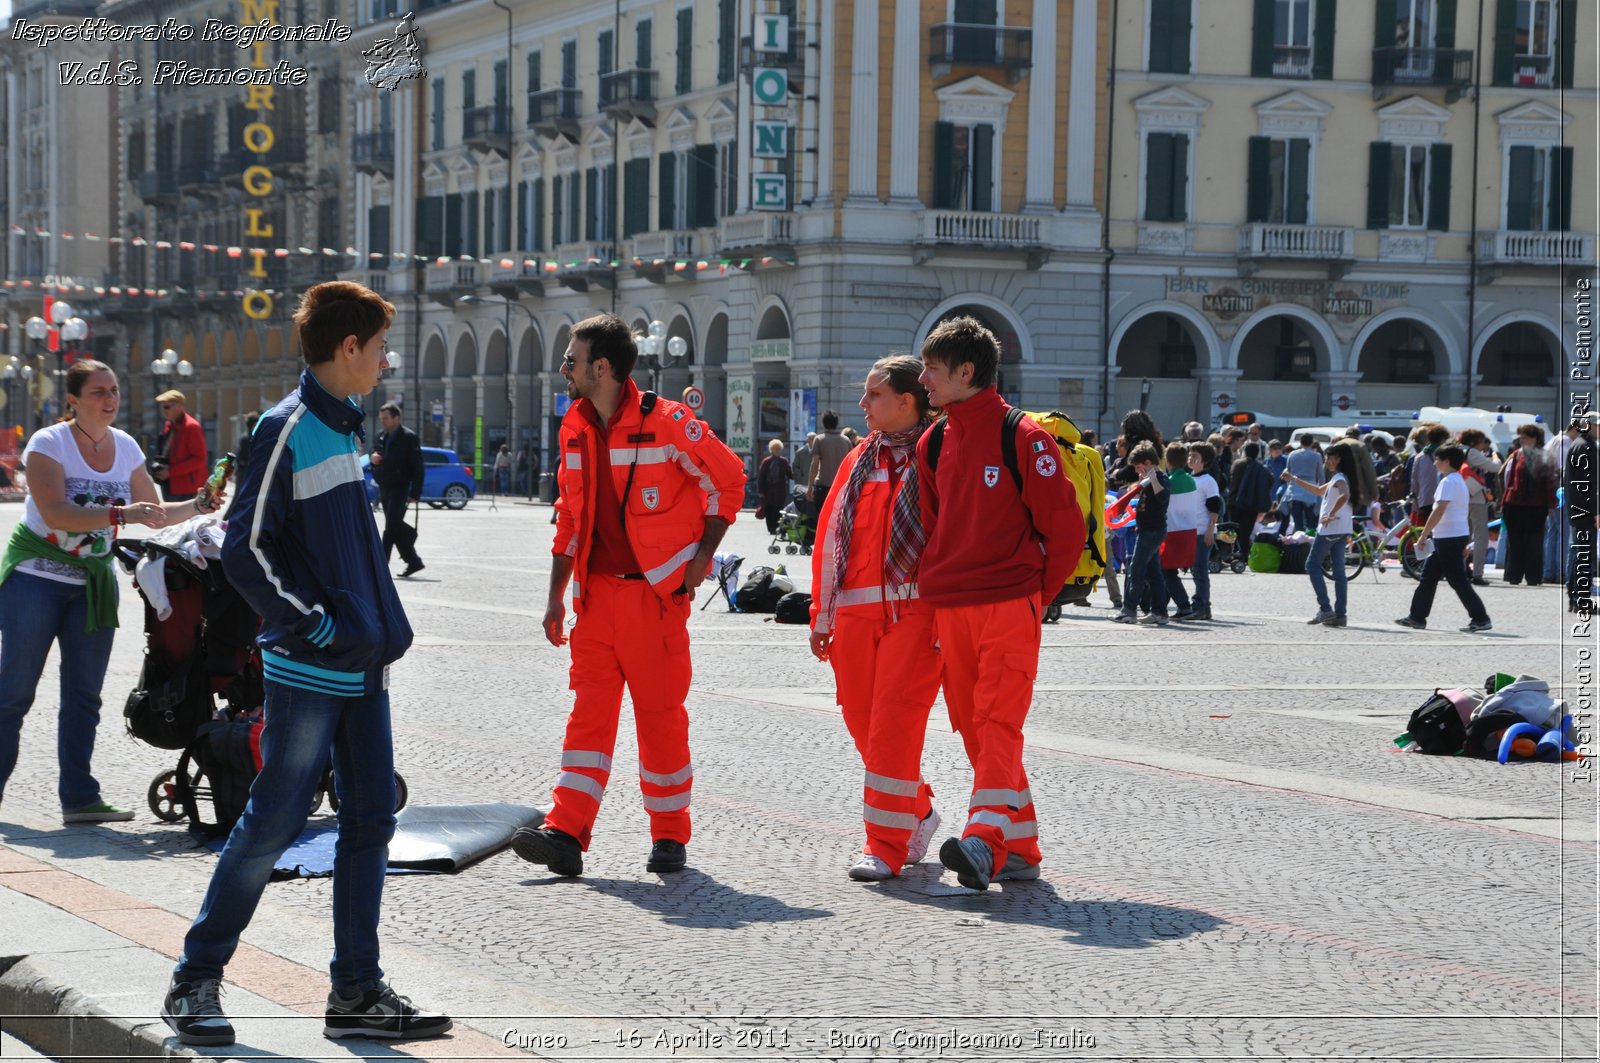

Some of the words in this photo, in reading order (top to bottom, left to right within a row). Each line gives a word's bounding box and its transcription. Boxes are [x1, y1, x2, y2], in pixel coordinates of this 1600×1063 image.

[1169, 279, 1209, 294] BAR
[1361, 282, 1408, 300] ARIONE
[1205, 297, 1252, 312] MARTINI
[1324, 301, 1371, 316] MARTINI
[689, 395, 700, 404] 40
